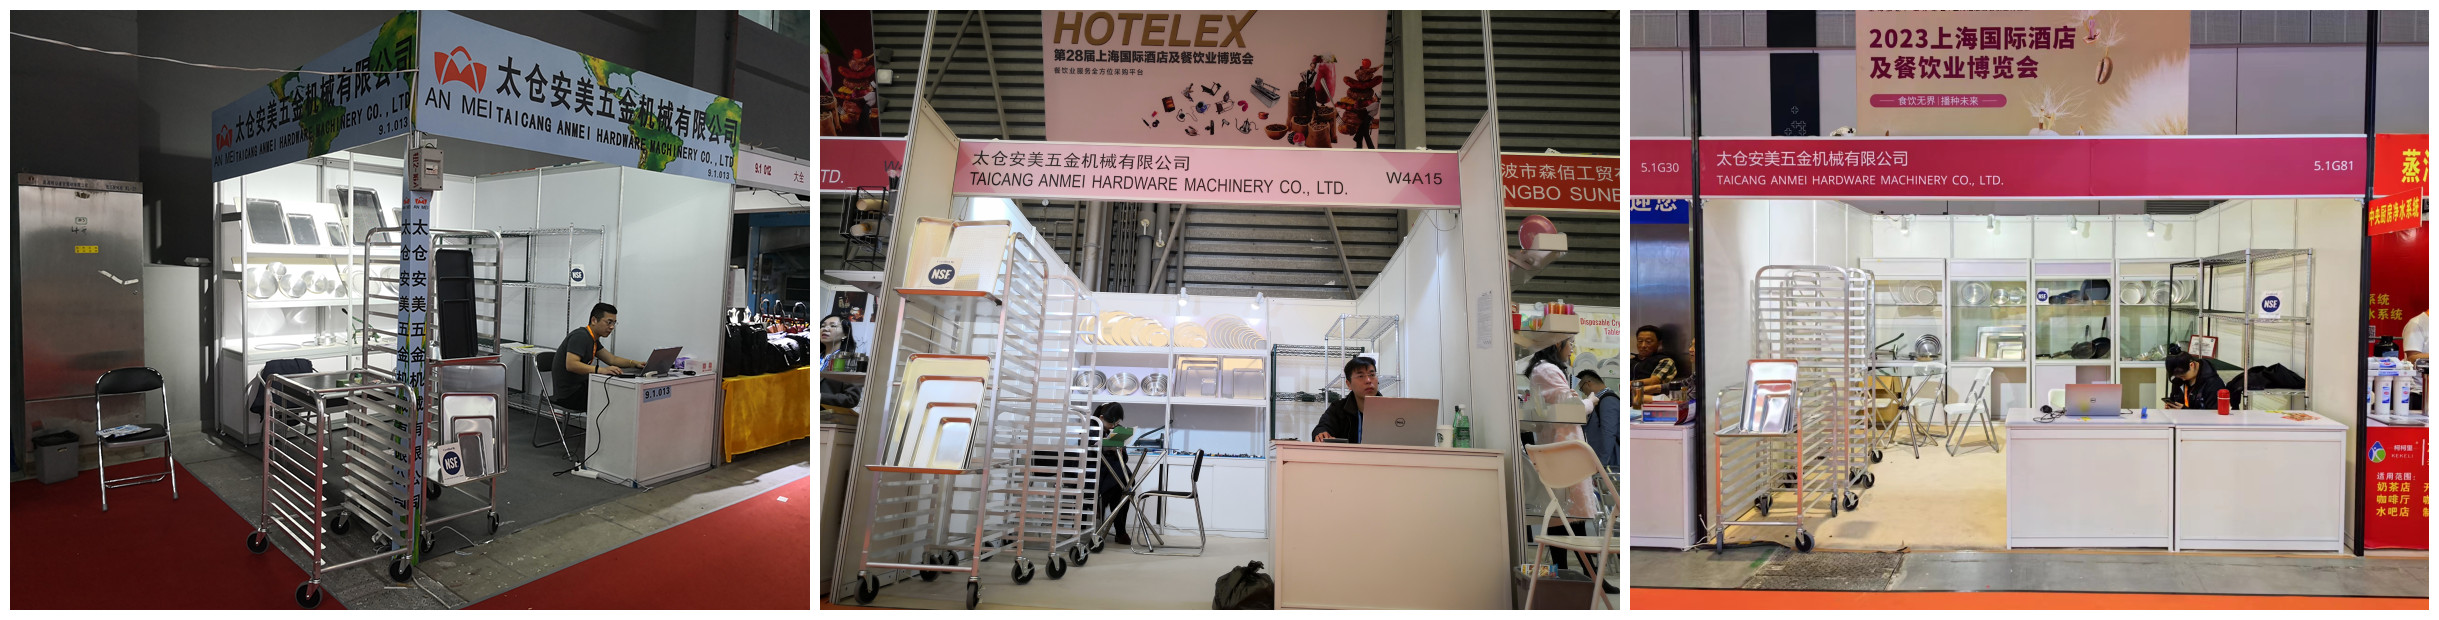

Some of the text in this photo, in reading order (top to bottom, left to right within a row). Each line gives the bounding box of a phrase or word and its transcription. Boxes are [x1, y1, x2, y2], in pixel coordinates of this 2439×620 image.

[1053, 10, 1257, 48] HOTELEX
[1869, 26, 2076, 50] 2023上海国际酒店
[1053, 48, 1254, 65] 第28届上海国际酒店及餐饮业博览会
[1054, 67, 1144, 76] 餐饮业服务全方位采购平台
[1870, 55, 2039, 79] 及餐饮业博览会
[235, 35, 413, 144] 太仓安美五金机械有限公司
[425, 87, 493, 119] AN MEI
[496, 56, 738, 147] 太仓安美五金机械有限公司
[378, 116, 408, 135] 9.1.013
[496, 106, 551, 133] TAICANG
[557, 120, 591, 141] ANMEI
[596, 128, 646, 151] HARDWARE
[650, 139, 698, 161] MACHINERY
[236, 145, 258, 162] TAICANG
[260, 138, 277, 154] ANMEI
[280, 127, 314, 149] HARDWARE
[315, 109, 363, 138] MACHINERY
[213, 150, 236, 168] AN MEI
[971, 150, 1191, 172] 太仓安美五金机械有限公司
[1716, 150, 1908, 167] 太仓安美五金机械有限公司
[2314, 160, 2354, 171] 5.1G81
[707, 168, 730, 180] 9.1.013
[1641, 162, 1680, 173] 5.1G30
[970, 172, 1348, 197] TAICANG ANMEI HARDWARE MACHINERY CO., LTD.
[1386, 172, 1443, 185] W4A15
[1716, 175, 2004, 187] TAICANG ANMEI HARDWARE MACHINERY CO., LTD.
[2369, 196, 2420, 227] 中央厨房净水系统
[931, 269, 952, 280] NSF
[2264, 300, 2278, 309] NSF
[1580, 318, 1610, 327] Disposable
[645, 387, 670, 399] 9.1.013
[445, 457, 459, 470] NSF
[2377, 482, 2410, 493] 奶茶店
[2376, 494, 2410, 505] 咖啡厅
[2376, 506, 2410, 517] 水吧店
